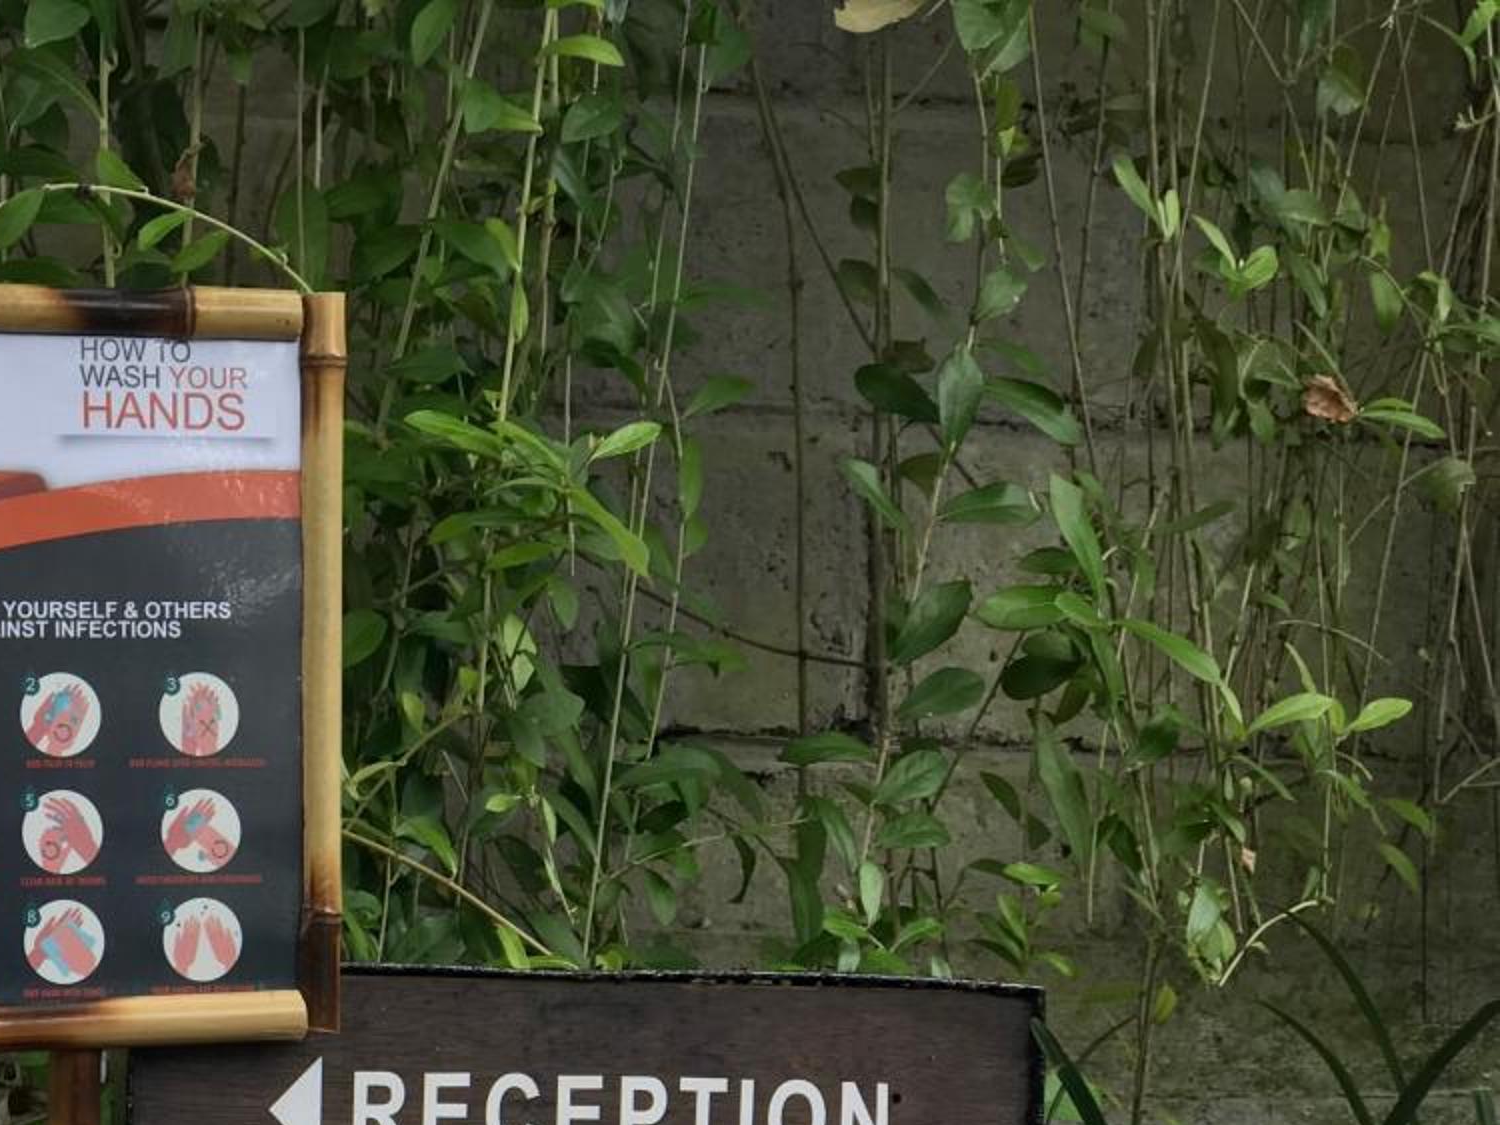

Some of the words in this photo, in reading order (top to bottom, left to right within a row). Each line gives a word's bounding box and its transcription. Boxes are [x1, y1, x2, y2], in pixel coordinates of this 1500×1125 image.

[80, 339, 147, 362] HOW
[157, 339, 191, 363] TO
[80, 364, 160, 388] WASH
[169, 366, 248, 389] YOUR
[83, 391, 245, 431] HANDS
[3, 601, 117, 619] YOURSELF
[123, 601, 139, 619] &
[145, 601, 231, 619] OTHERS
[55, 621, 181, 638] INFECTIONS
[26, 678, 36, 692] 2
[166, 677, 176, 691] 3
[161, 910, 171, 924] 9
